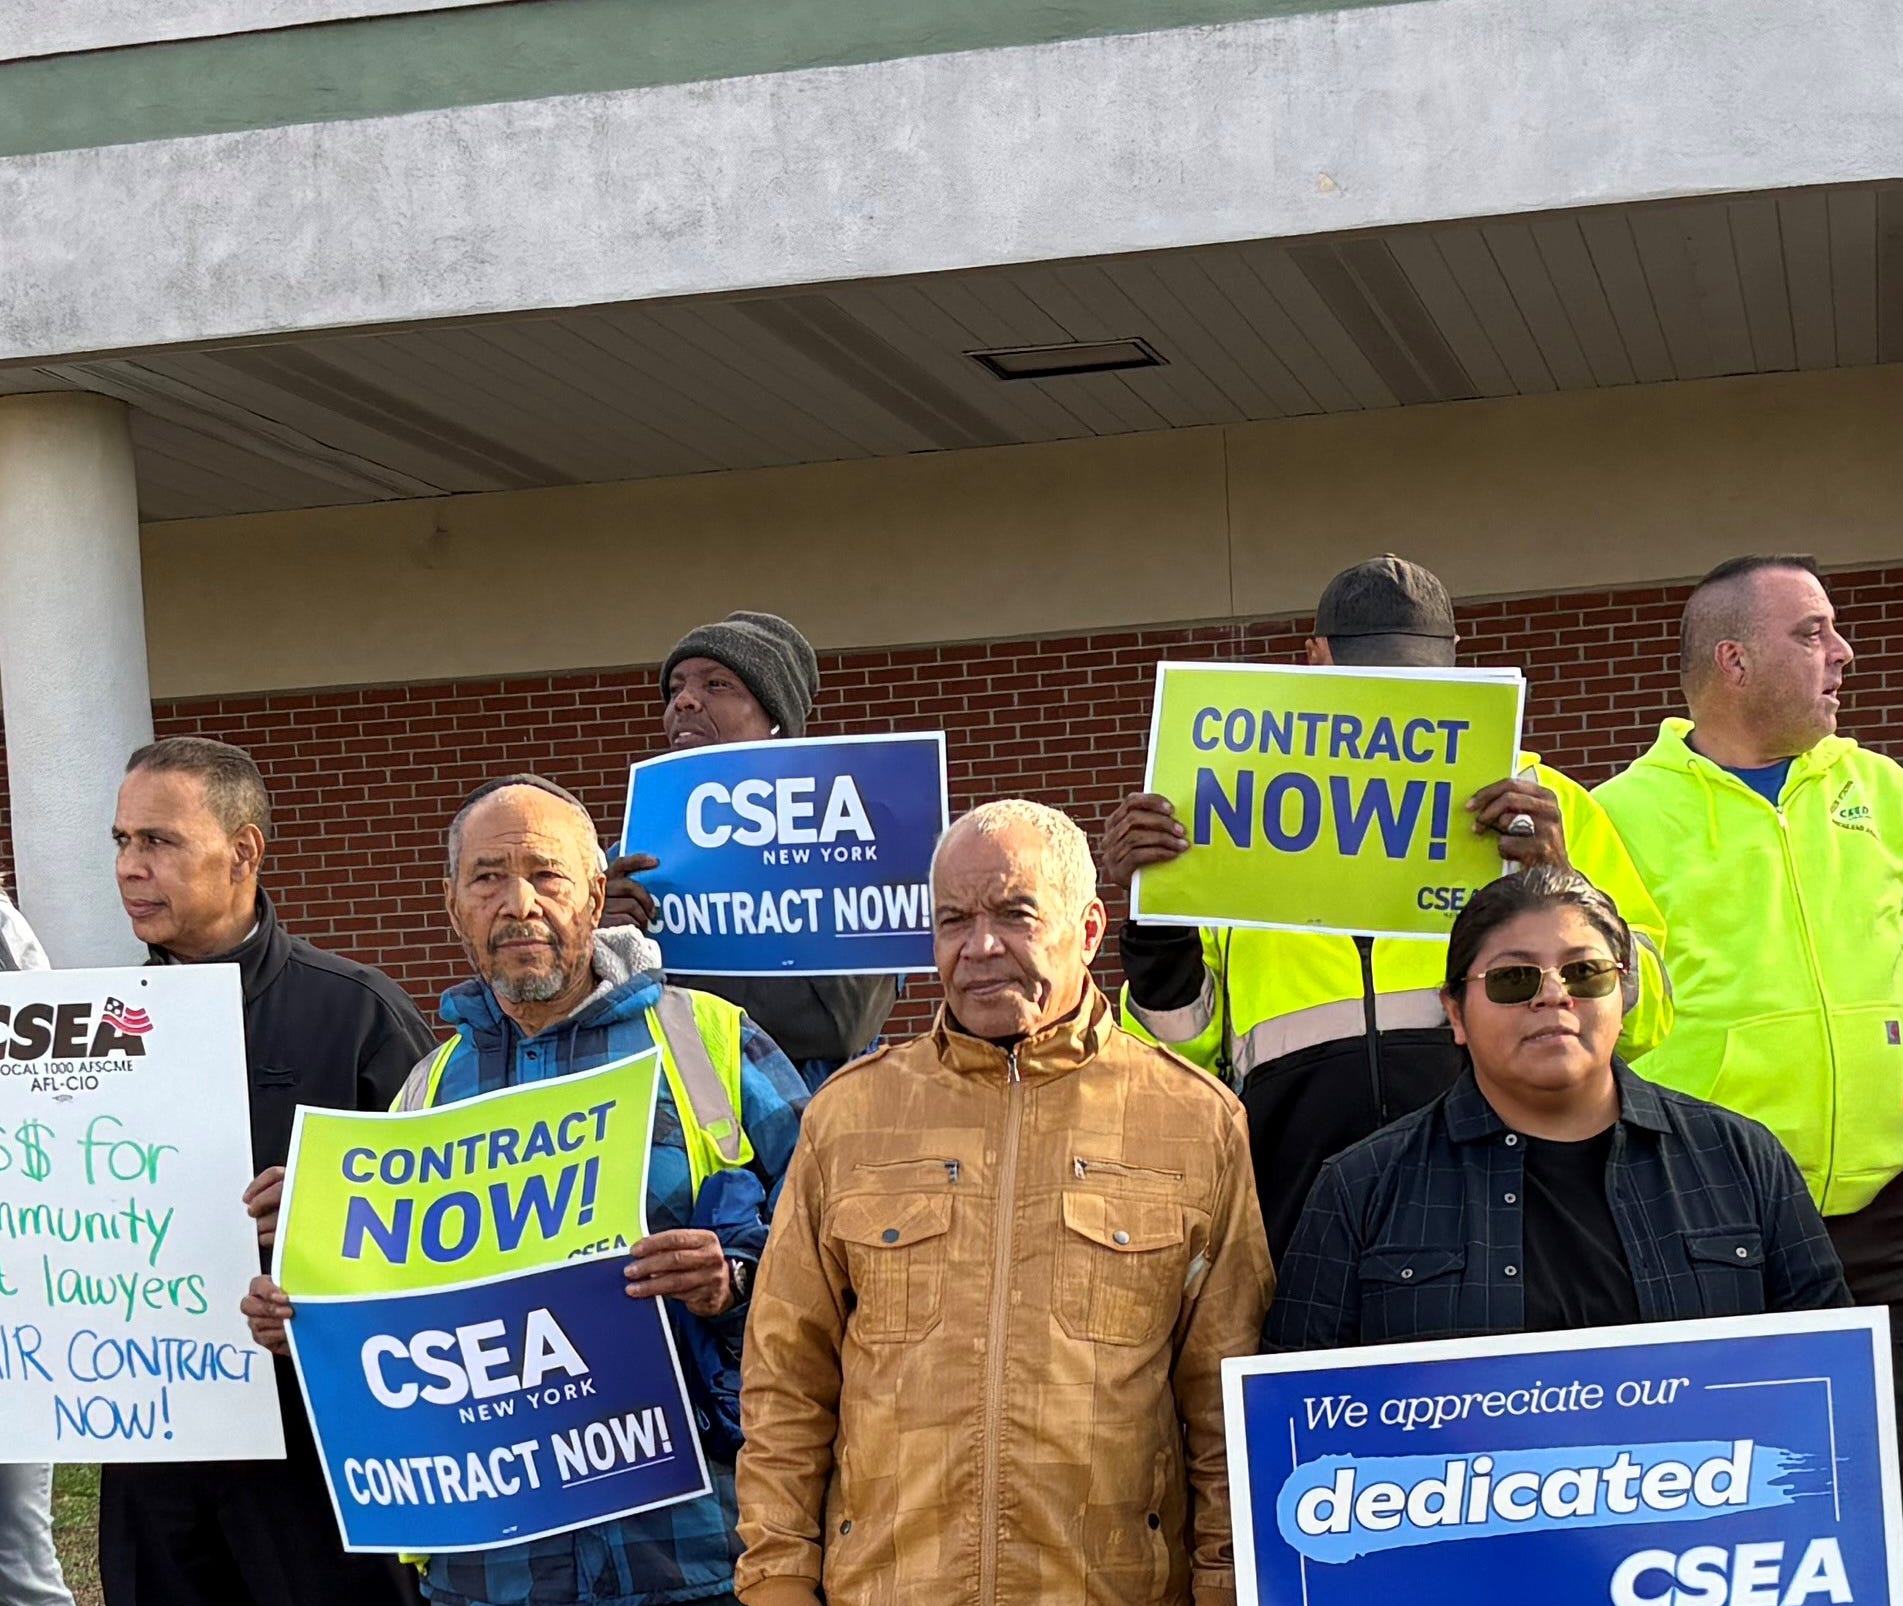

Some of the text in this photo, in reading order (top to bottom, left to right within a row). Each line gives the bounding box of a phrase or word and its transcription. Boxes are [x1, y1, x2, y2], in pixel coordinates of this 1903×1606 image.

[1190, 706, 1470, 767] CONTRACT
[686, 775, 875, 848] CSEA
[1193, 767, 1452, 861] NOW!
[763, 846, 878, 865] NEW YORK
[834, 884, 930, 932] NOW!
[1417, 887, 1478, 911] CSE
[31, 1075, 99, 1092] AFL-CIO
[44, 1062, 73, 1074] 1000
[79, 1060, 133, 1073] AFSCME
[77, 1114, 179, 1185] for
[341, 1101, 616, 1185] CONTRACT
[341, 1157, 599, 1265] NOW!
[42, 1254, 208, 1315] lawyers
[68, 1329, 260, 1384] CONTRACT
[361, 1308, 590, 1409] CSEA
[54, 1385, 172, 1441] NOW!
[459, 1379, 597, 1424] NEW YORK
[1304, 1374, 1691, 1433] We appreciate our
[343, 1407, 673, 1506] CONTRACT NOW!
[1295, 1439, 1755, 1536] dedicated
